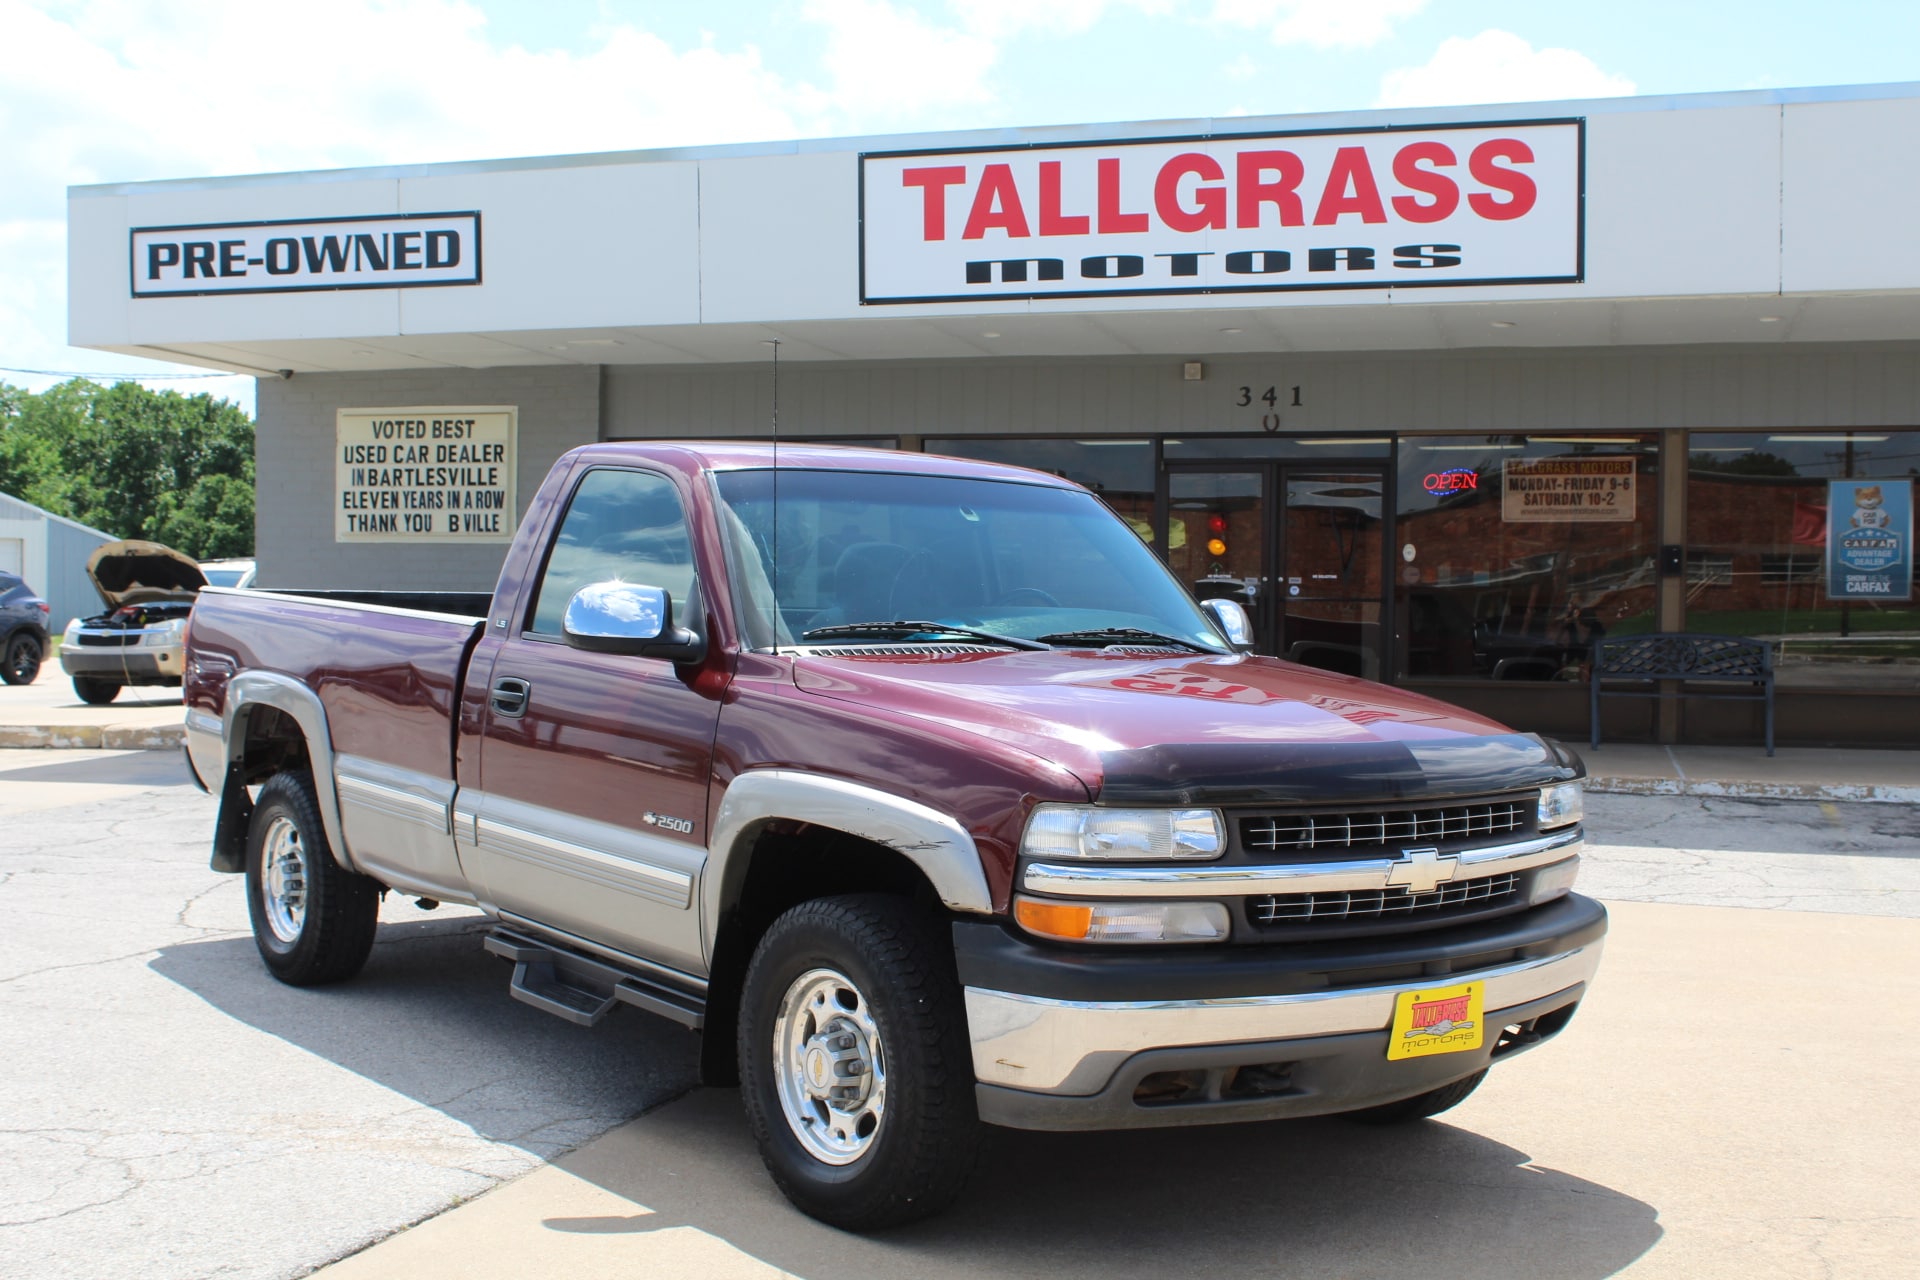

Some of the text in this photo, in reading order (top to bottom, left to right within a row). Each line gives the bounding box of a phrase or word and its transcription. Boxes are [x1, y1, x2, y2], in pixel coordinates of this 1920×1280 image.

[902, 138, 1537, 241] TALLGRASS
[148, 230, 460, 280] PRE-OWNED
[966, 243, 1462, 284] MOTORS
[372, 420, 476, 439] VOTED BEST
[344, 444, 504, 464] USED CAR DEALER
[368, 467, 498, 486] BARTLESVILLE
[1580, 462, 1630, 473] MOTORS
[1423, 473, 1478, 490] OPEN
[1508, 477, 1630, 491] MONDAY-FRIDAY 9-6
[343, 490, 505, 509] ELEVEN YEARS IN A ROW
[1524, 492, 1615, 506] SATURDAY 10-2
[348, 514, 500, 532] THANK YOU B VILLE
[1854, 558, 1885, 566] DEALER
[1846, 582, 1891, 592] CARFAX
[658, 816, 694, 834] 2500
[1402, 1032, 1474, 1049] MOTORS
